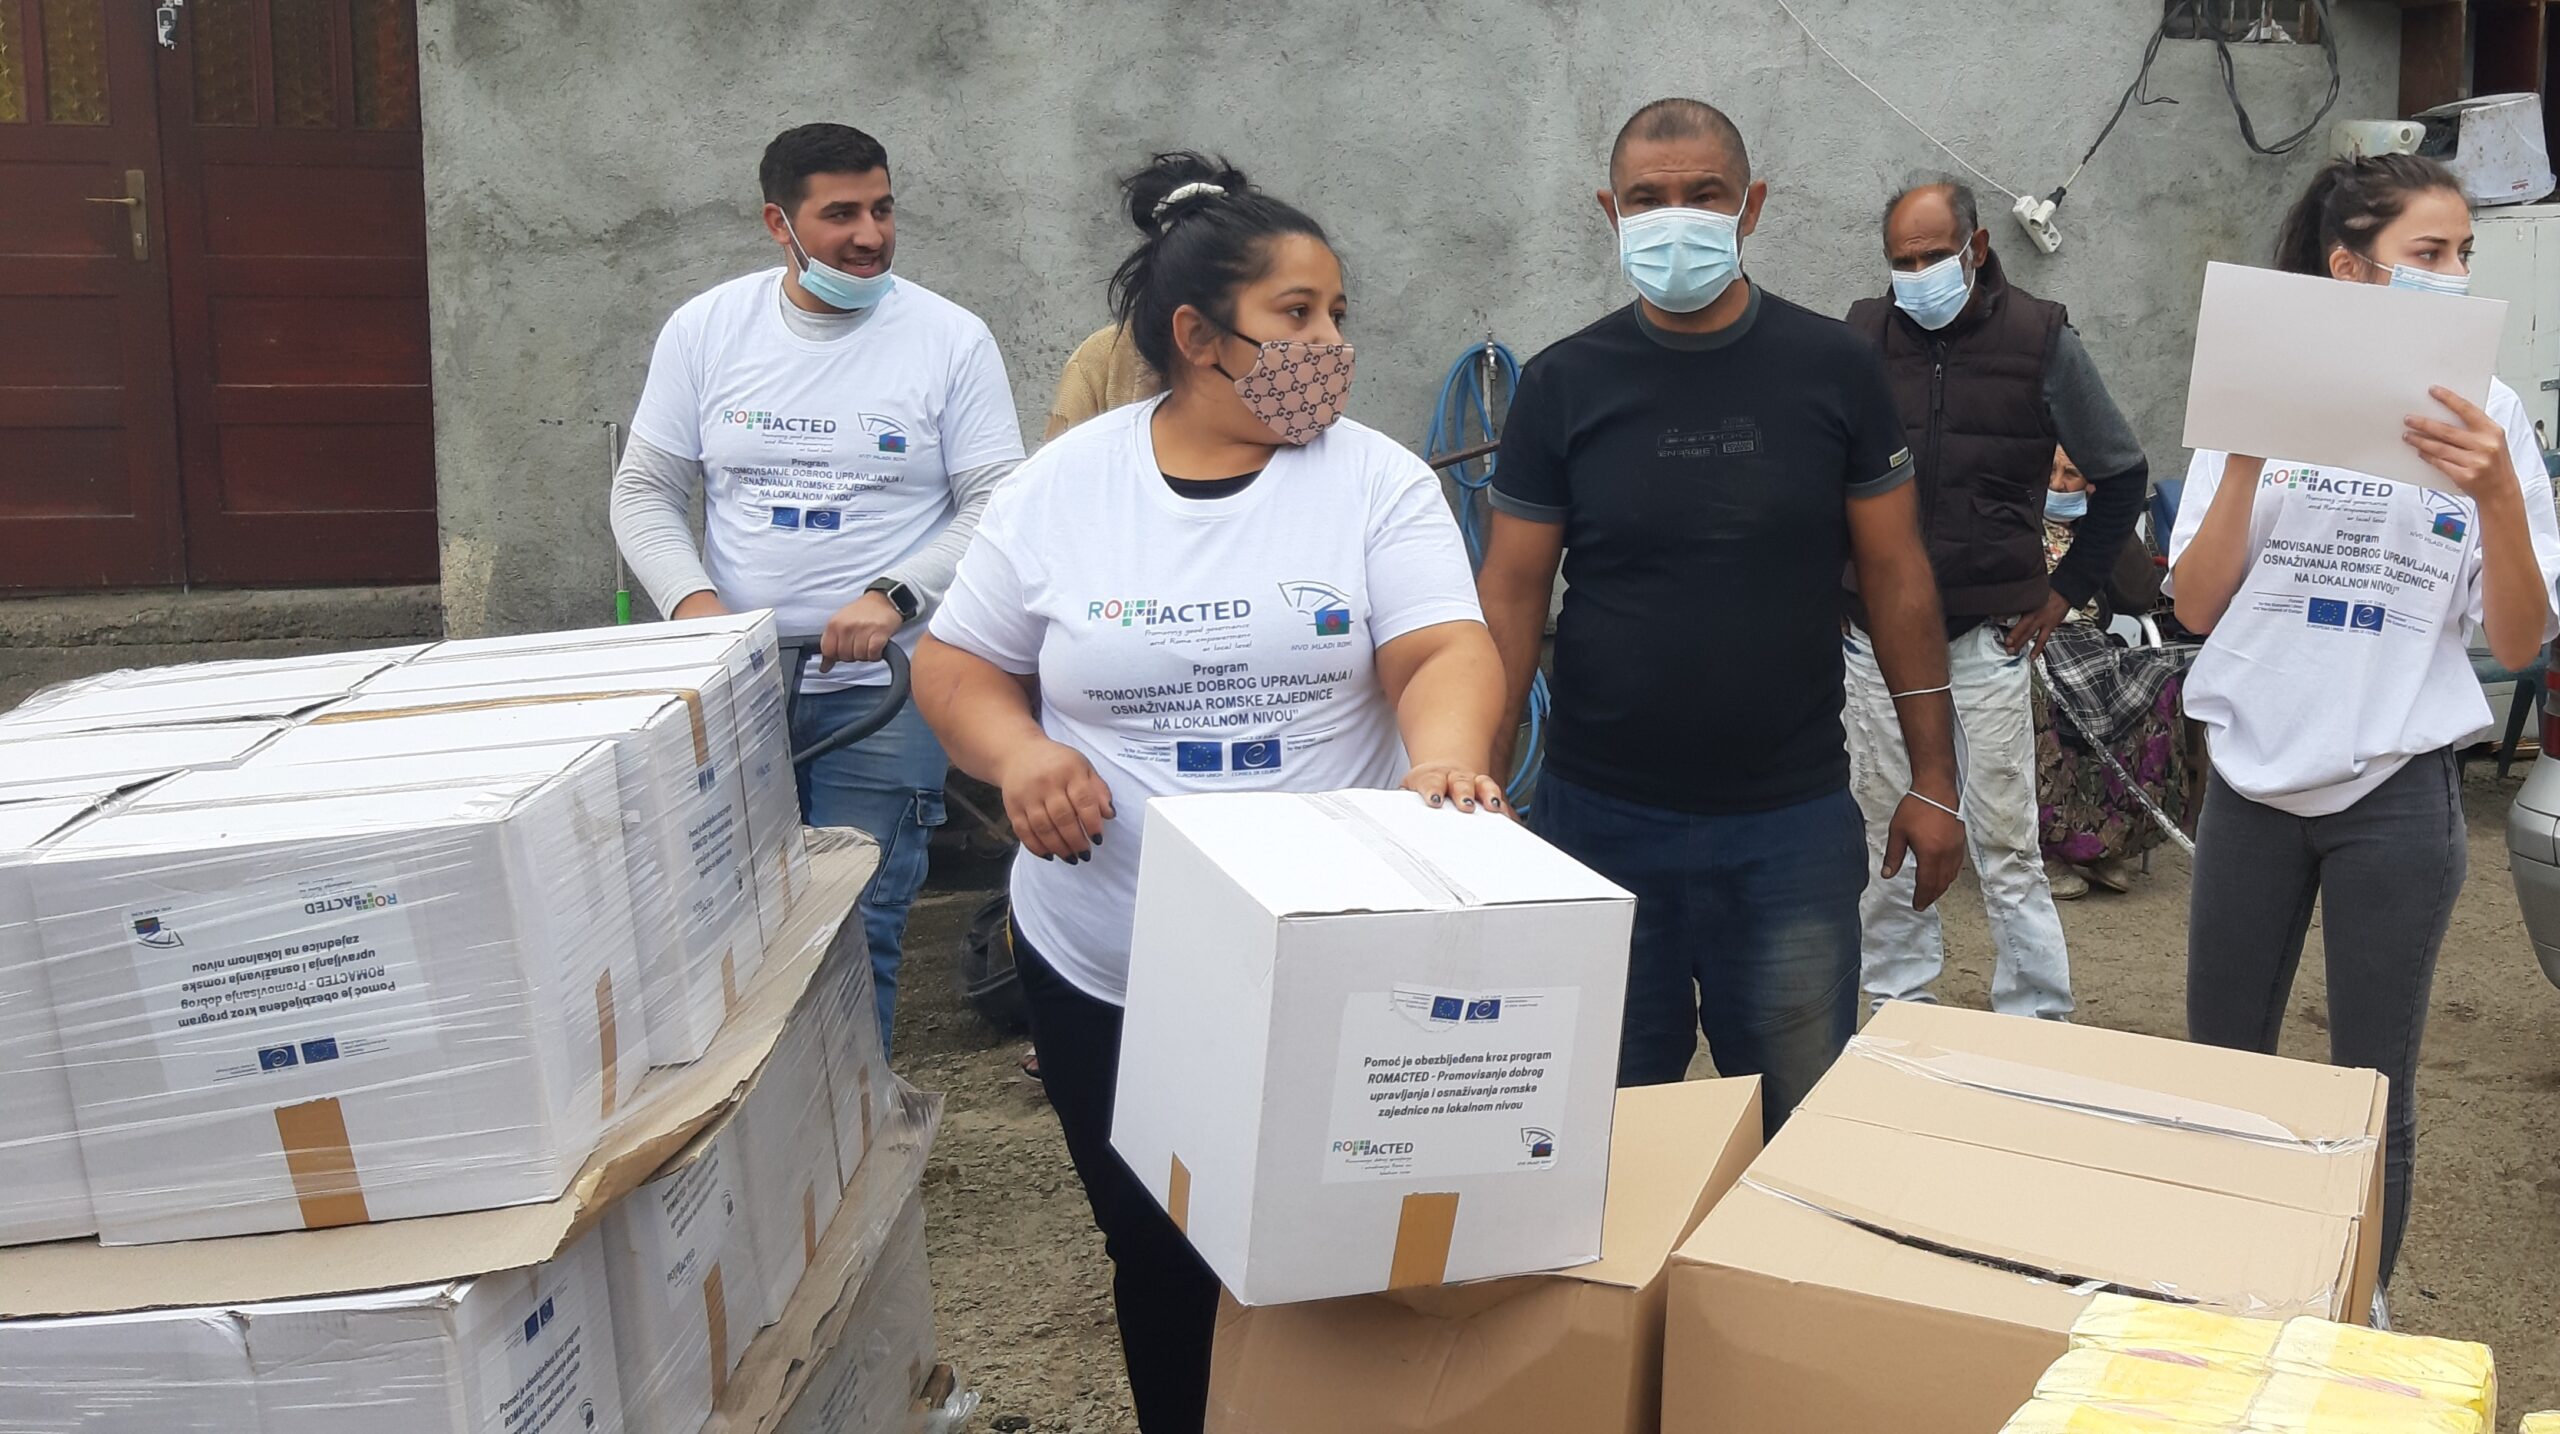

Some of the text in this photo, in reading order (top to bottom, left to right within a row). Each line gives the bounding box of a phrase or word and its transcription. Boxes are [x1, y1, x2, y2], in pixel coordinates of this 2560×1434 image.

[791, 458, 829, 468] Program
[792, 469, 833, 479] DOBROG
[796, 480, 836, 491] ROMSKE
[759, 489, 771, 497] NA
[773, 490, 823, 501] LOKALNOM
[2336, 530, 2380, 544] Program
[2336, 545, 2381, 559] DOBROG
[2383, 549, 2449, 582] UPRAVLJANJA
[2263, 554, 2436, 592] OSNAŽIVANJA ROMSKE ZAJEDNICE
[2294, 572, 2309, 583] NA
[1193, 662, 1249, 677] Program
[1196, 676, 1257, 693] DOBROG
[1260, 669, 1347, 689] UPRAVLJANJA
[1111, 687, 1334, 715] OSNAŽIVANJA ROMSKE ZAJEDNICE
[1153, 717, 1174, 731] NA
[1174, 712, 1249, 730] LOKALNOM
[192, 935, 360, 973] zajednice na lokalnom nivou
[308, 949, 376, 971] upravljanja
[229, 964, 300, 985] osnaživanja
[316, 964, 385, 988] ROMACTED
[182, 977, 226, 993] romske
[224, 980, 306, 1004] Promovisanje
[341, 986, 353, 999] je
[354, 981, 396, 998] Pomoć
[180, 995, 222, 1009] dobrog
[178, 1009, 228, 1028] program
[230, 1007, 258, 1016] kroz
[1364, 1056, 1401, 1068] Pomoć
[1401, 1056, 1413, 1069] je
[1486, 1051, 1508, 1062] kroz
[1509, 1052, 1552, 1064] program
[1367, 1071, 1430, 1084] ROMACTED
[1437, 1068, 1507, 1081] Promovisanje
[1508, 1066, 1544, 1078] dobrog
[1370, 1087, 1430, 1103] upravljanja
[1436, 1085, 1498, 1098] osnaživanja
[1500, 1082, 1538, 1095] romske
[1378, 1100, 1524, 1119] zajednice na lokalnom nivou
[504, 1392, 534, 1429] ROMACTED
